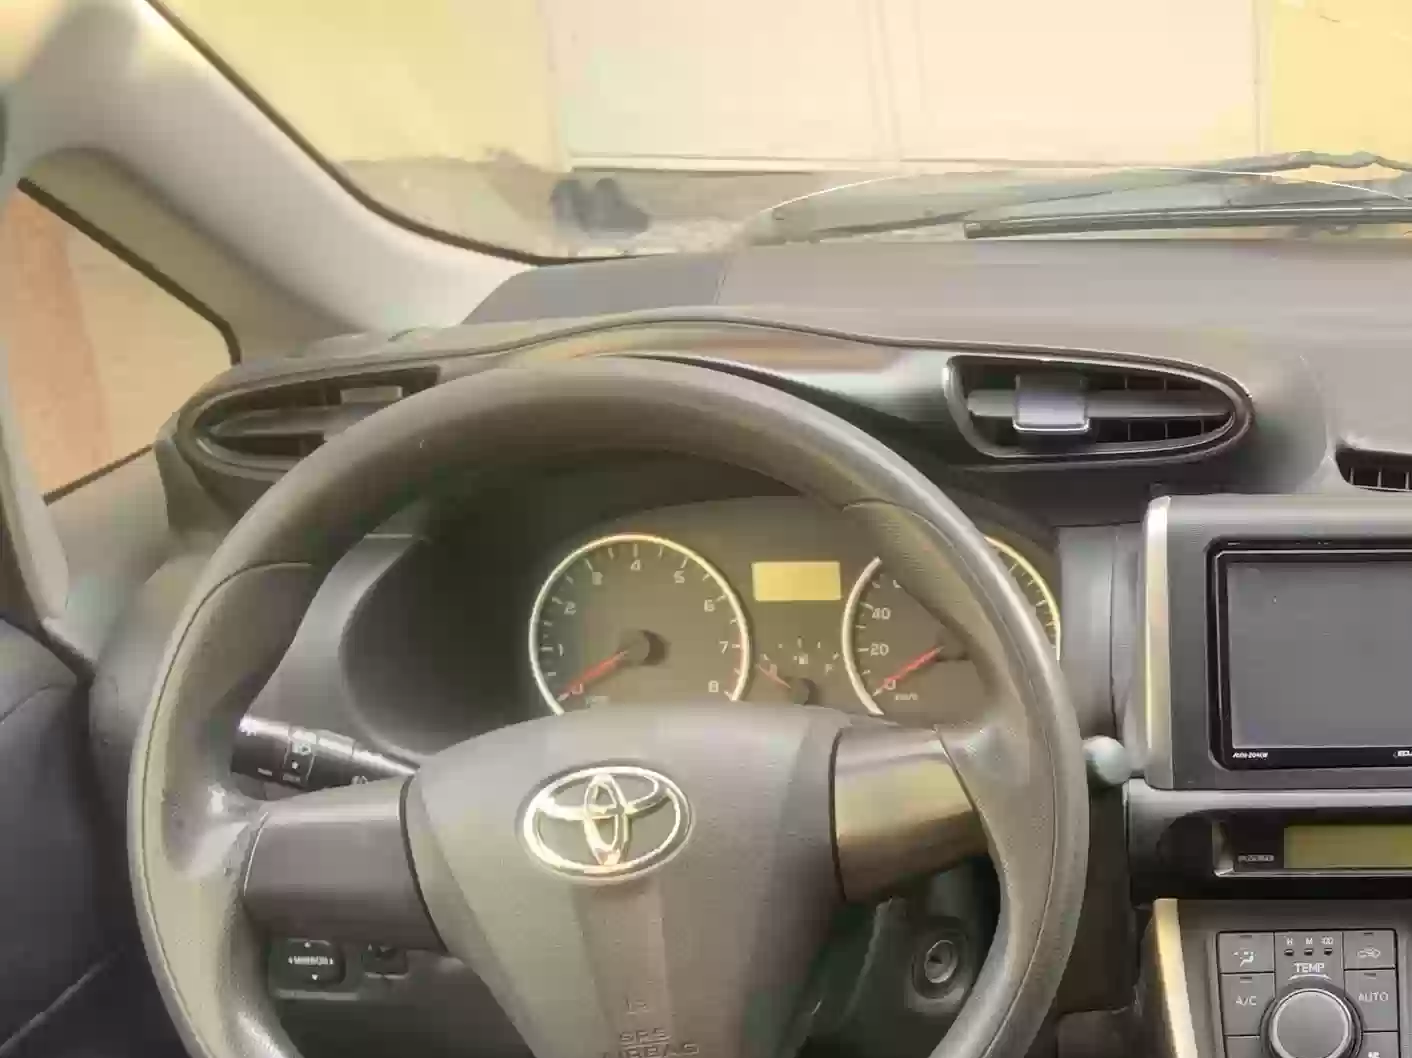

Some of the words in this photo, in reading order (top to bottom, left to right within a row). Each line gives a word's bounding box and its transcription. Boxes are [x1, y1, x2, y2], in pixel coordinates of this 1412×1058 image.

[630, 559, 642, 571] 4
[564, 602, 576, 615] 2
[872, 607, 891, 620] 40
[719, 640, 729, 654] 7
[870, 643, 889, 656] 20
[1294, 962, 1325, 973] TEMP
[1235, 995, 1257, 1007] A/C
[1358, 991, 1389, 1002] AUTO
